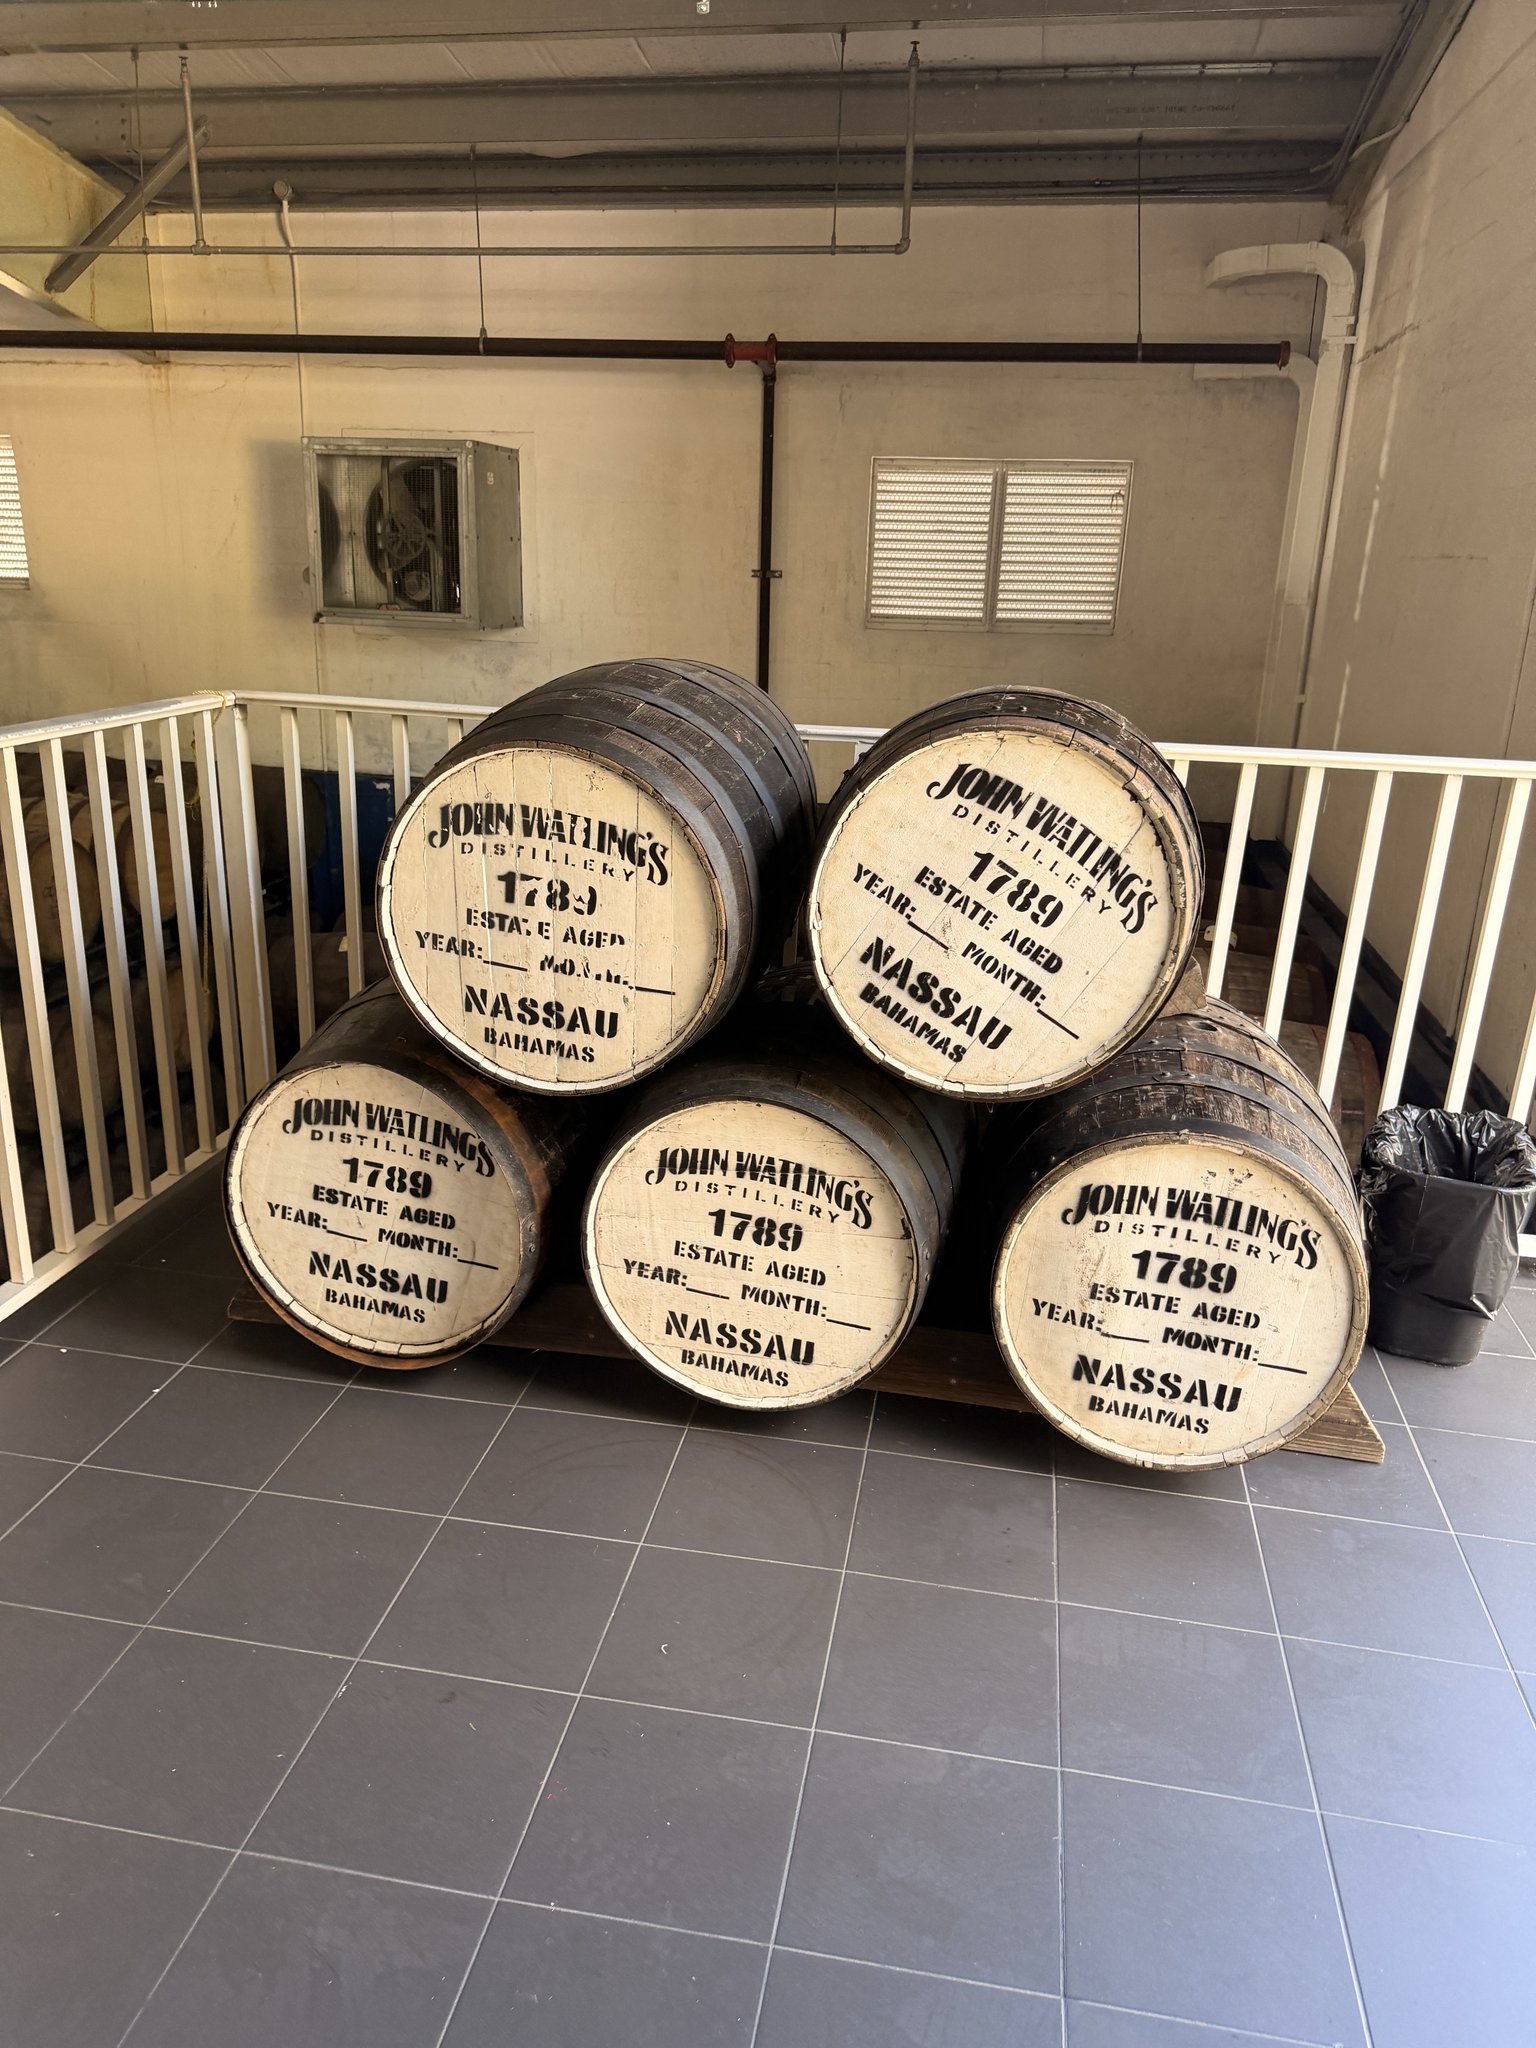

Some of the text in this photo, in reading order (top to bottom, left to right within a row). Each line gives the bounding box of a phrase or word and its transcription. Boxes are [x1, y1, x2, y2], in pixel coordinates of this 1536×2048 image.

[428, 802, 514, 849] JOHN
[926, 762, 1158, 935] JOHN WATLING'S
[461, 842, 635, 882] DISTILLERY
[952, 803, 1112, 915] DISTILLERY
[497, 871, 598, 916] 1789
[967, 851, 1064, 929] 1789
[853, 862, 1047, 1008] YEAR: MONTH:
[914, 865, 1063, 974] ESTATE AGED
[415, 930, 483, 960] YEAR:
[464, 984, 619, 1039] NASSAU
[860, 936, 1013, 1050] NASSAU
[484, 1026, 596, 1064] BAHAMAS
[859, 982, 968, 1063] BAHAMAS
[282, 1097, 360, 1135] JOHN
[311, 1129, 465, 1172] DISTILLERY
[342, 1157, 432, 1199] 1789
[645, 1147, 874, 1230] JOHN WATLING'S
[312, 1184, 456, 1230] ESTATE AGED
[675, 1181, 840, 1224] DISTILLERY
[267, 1201, 458, 1259] YEAR: MONTH:
[708, 1208, 803, 1252] 1789
[1061, 1183, 1322, 1271] JOHN WATLING'S
[1094, 1220, 1281, 1265] DISTILLERY
[309, 1250, 449, 1304] NASSAU
[674, 1240, 826, 1287] ESTATE AGED
[1132, 1249, 1238, 1294] 1789
[325, 1288, 426, 1324] BAHAMAS
[623, 1258, 827, 1317] YEAR: MONTH:
[1089, 1282, 1260, 1330] ESTATE AGED
[665, 1310, 815, 1365] NASSAU
[1032, 1298, 1260, 1362] YEAR: MONTH:
[681, 1349, 789, 1388] BAHAMAS
[1072, 1354, 1242, 1413] NASSAU
[1088, 1395, 1210, 1435] BAHAMAS
